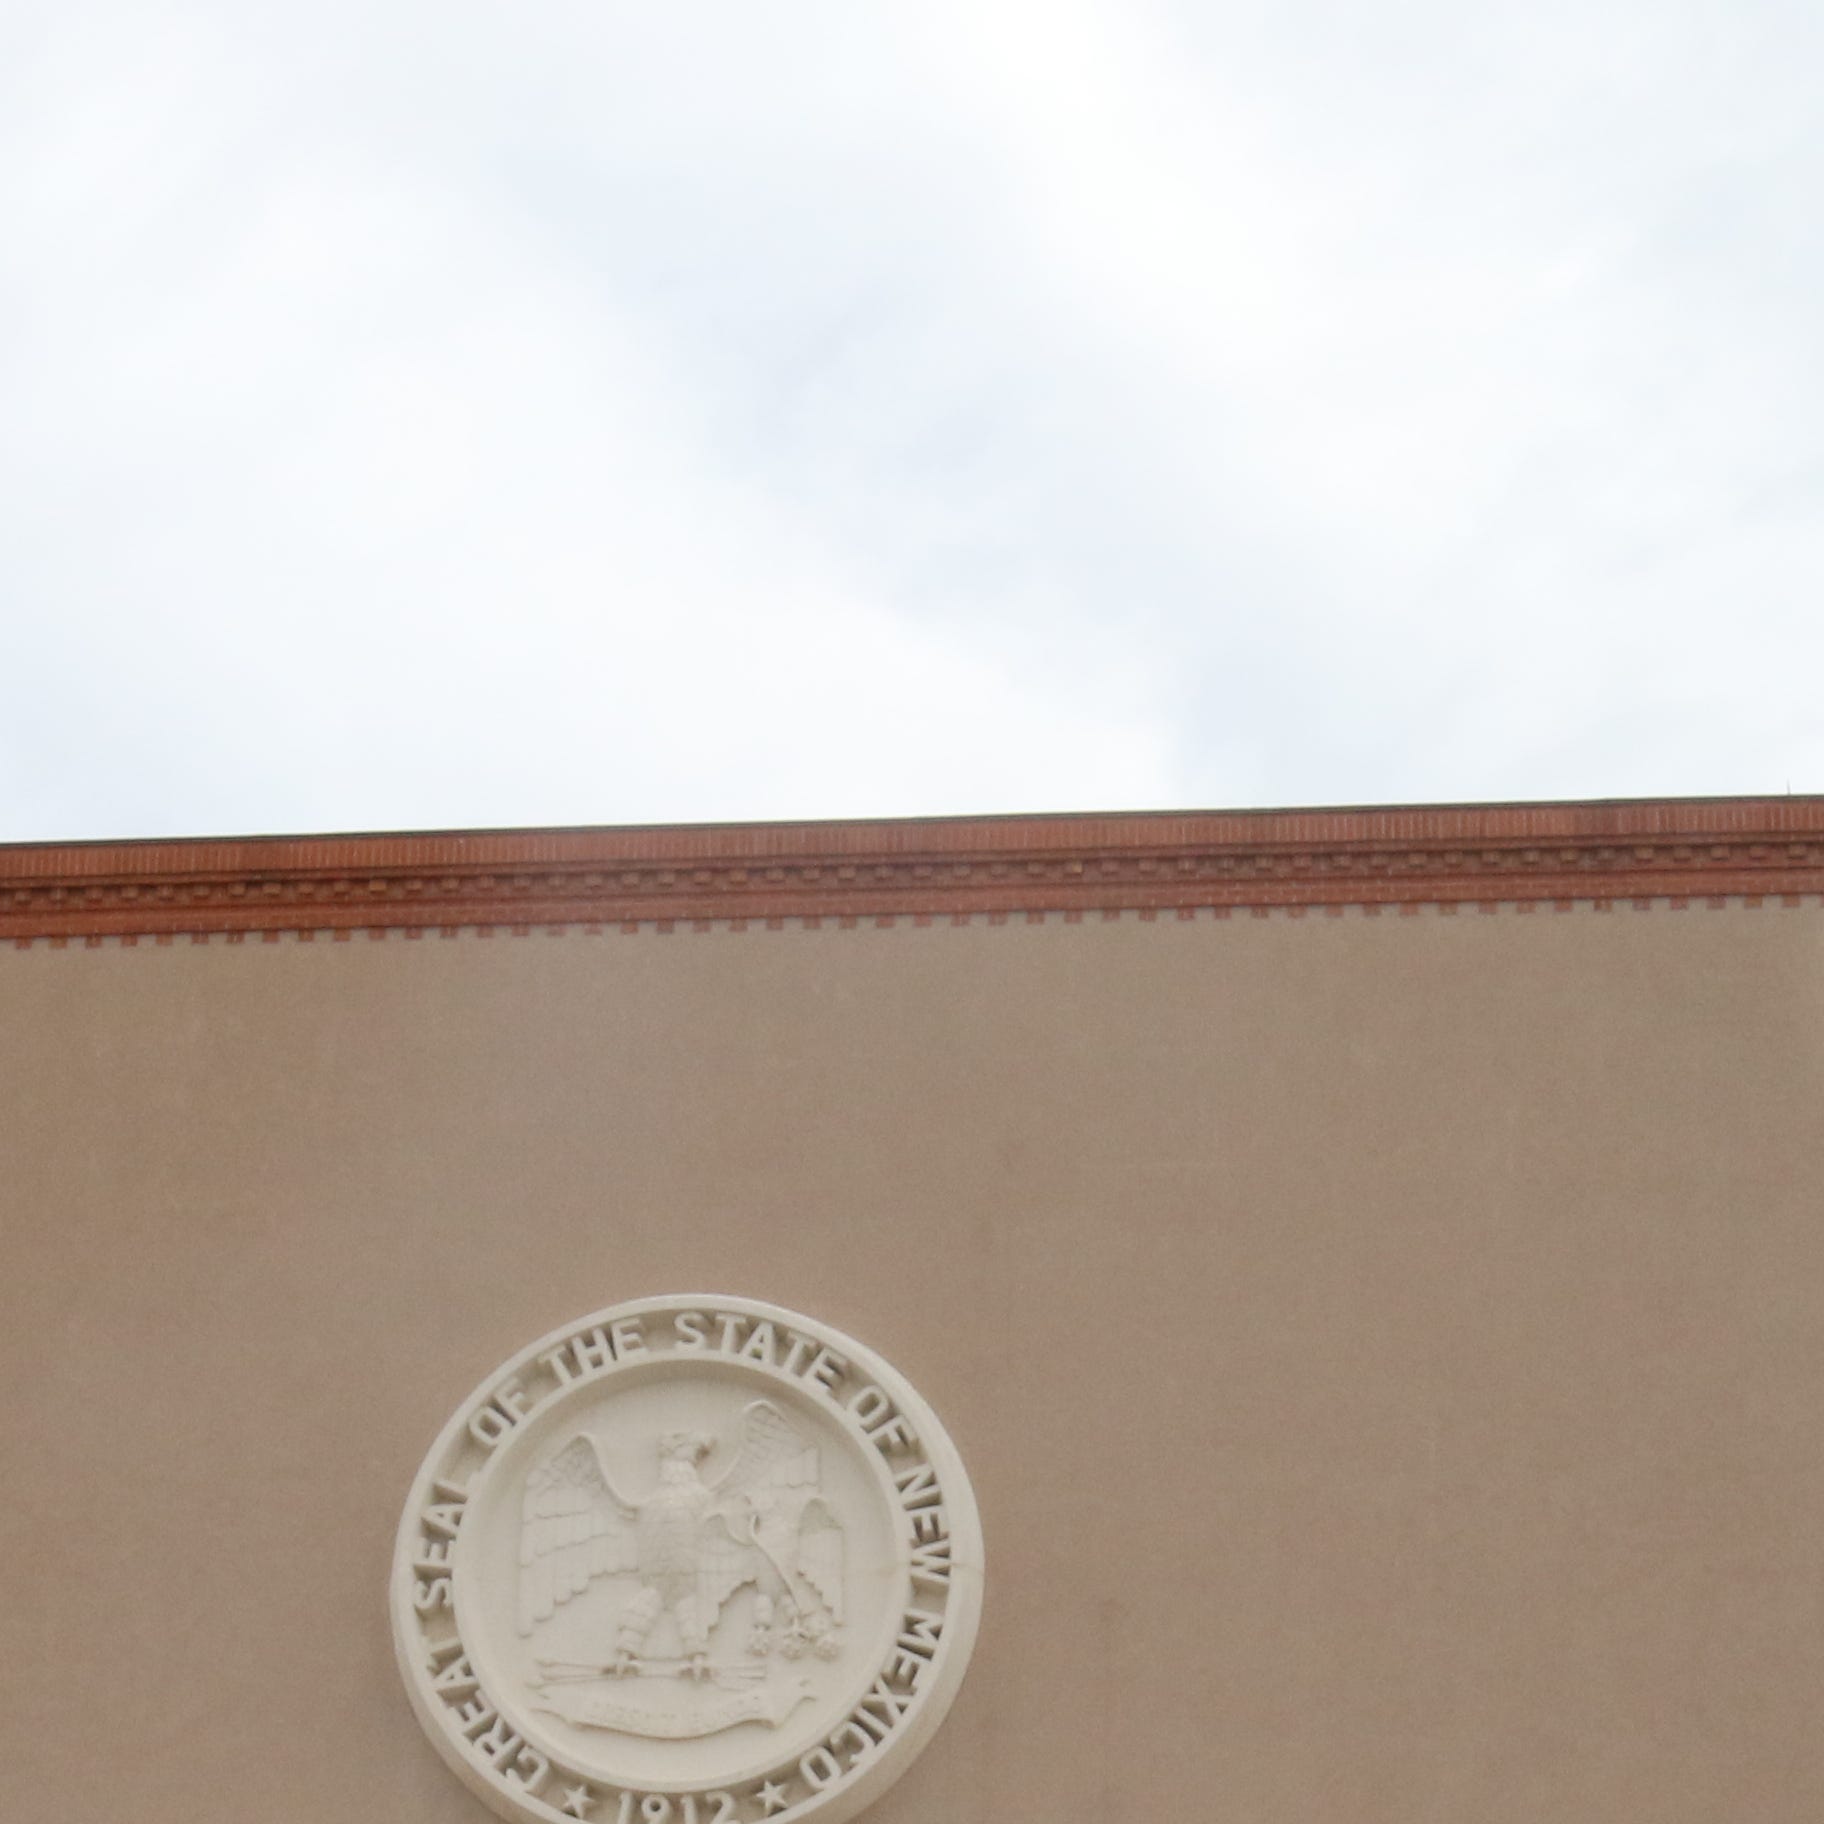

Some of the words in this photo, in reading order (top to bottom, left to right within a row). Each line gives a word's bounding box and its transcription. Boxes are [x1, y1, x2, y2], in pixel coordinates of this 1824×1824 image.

[537, 1318, 647, 1386] THE
[674, 1311, 848, 1391] STATE
[467, 1376, 528, 1447] OF
[848, 1385, 920, 1449] OF
[412, 1471, 479, 1609] SEAL
[895, 1463, 952, 1582] NEW
[423, 1637, 550, 1792] GREAT
[799, 1609, 945, 1791] MEXICO
